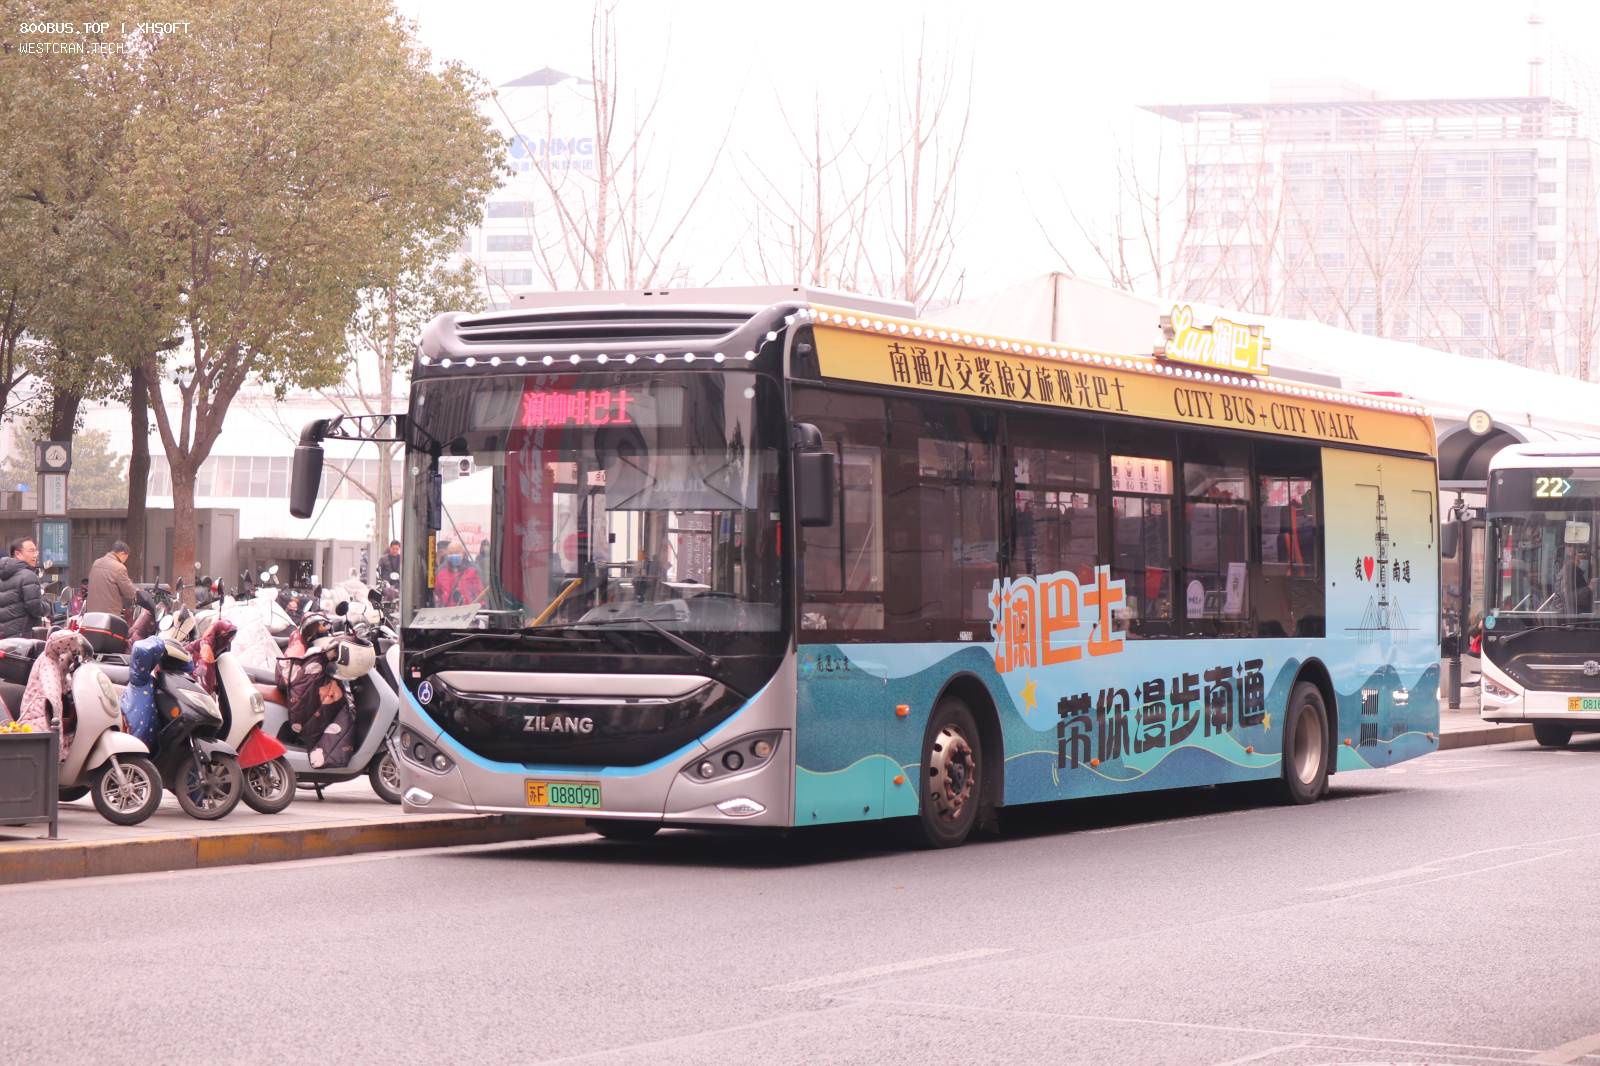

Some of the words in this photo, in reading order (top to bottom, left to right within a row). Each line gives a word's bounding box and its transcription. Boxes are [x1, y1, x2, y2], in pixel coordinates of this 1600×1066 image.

[539, 137, 593, 156] NMG
[887, 342, 1129, 412] 南通公交紫琅文旅观光巴士
[522, 390, 635, 426] 澜咖啡巴士
[1173, 387, 1214, 420] CITY
[1220, 393, 1256, 426] BUS
[1271, 402, 1308, 434] CITY
[1311, 409, 1359, 441] WALK
[1536, 477, 1563, 497] 22
[991, 571, 1125, 675] 澜巴士
[523, 715, 594, 733] ZILANG
[1057, 658, 1265, 769] 带你漫步南通
